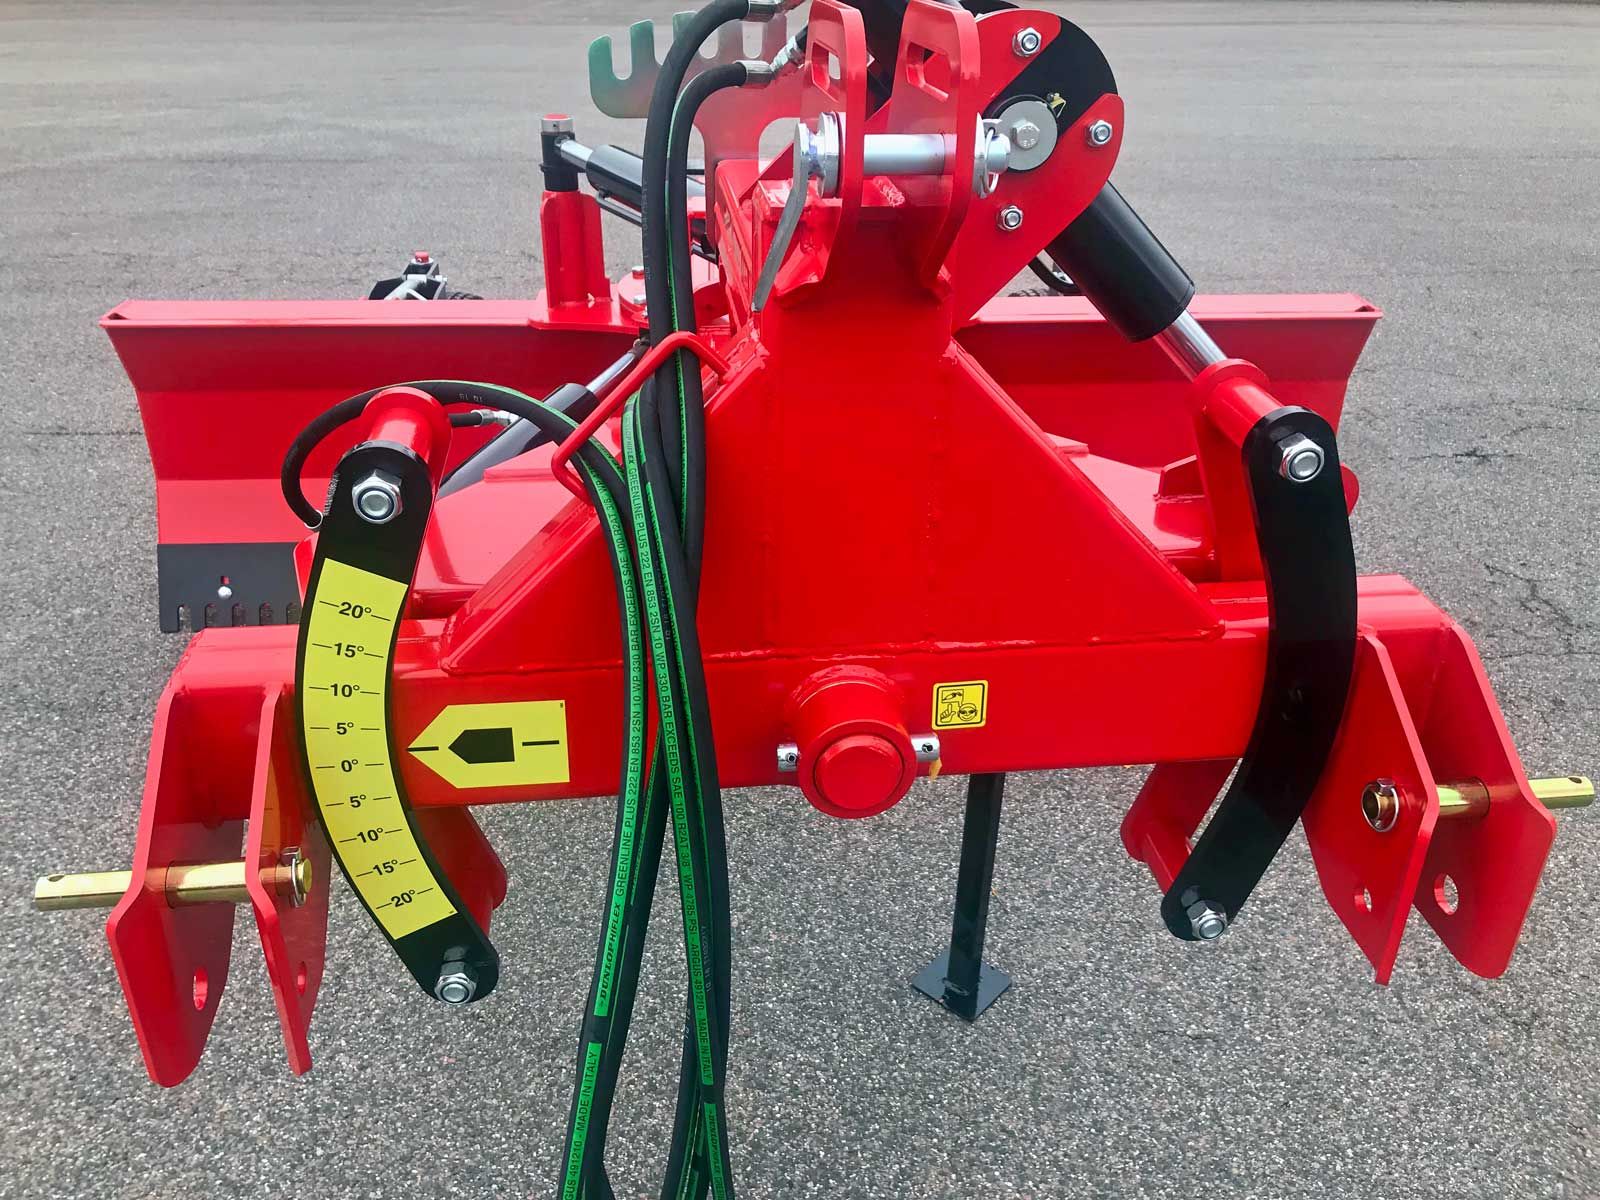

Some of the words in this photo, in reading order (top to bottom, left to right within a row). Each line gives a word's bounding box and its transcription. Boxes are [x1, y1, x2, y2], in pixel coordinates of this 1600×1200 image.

[628, 467, 643, 520] GREENLINE
[637, 522, 648, 549] PLUS
[616, 537, 627, 553] 100
[620, 558, 631, 577] SAE
[640, 552, 651, 569] 222
[644, 572, 654, 587] EN
[624, 580, 638, 626] EXCEEDS
[647, 591, 656, 609] 853
[339, 601, 372, 619] 20°
[650, 611, 661, 633] 2SN
[630, 629, 640, 651] BAR
[654, 637, 663, 648] 10
[334, 642, 364, 658] 15°
[633, 655, 641, 672] 330
[655, 651, 666, 669] WP
[330, 683, 360, 697] 10°
[632, 676, 641, 693] WP
[658, 674, 669, 692] 330
[633, 696, 642, 707] 10
[662, 696, 672, 718] BAR
[336, 721, 354, 735] 5°
[632, 711, 641, 733] 2SN
[631, 736, 640, 754] 853
[665, 722, 680, 773] EXCEEDS
[341, 759, 358, 772] 0°
[630, 757, 639, 773] EN
[627, 776, 638, 798] 222
[672, 776, 683, 798] SAE
[349, 794, 366, 808] 5°
[624, 800, 636, 828] PLUS
[675, 804, 685, 819] 100
[356, 827, 384, 844] 10°
[677, 822, 689, 849] R2AT
[372, 859, 398, 876] 15°
[615, 832, 631, 896] GREENLINE
[390, 889, 416, 908] 20°
[690, 944, 702, 977] ARGUS
[698, 1018, 709, 1043] MADE
[701, 1045, 710, 1055] IN
[584, 1052, 598, 1084] ITALY
[702, 1057, 713, 1079] ITALY
[582, 1084, 592, 1097] IN
[575, 1099, 589, 1131] MADE
[569, 1140, 583, 1177] 491210
